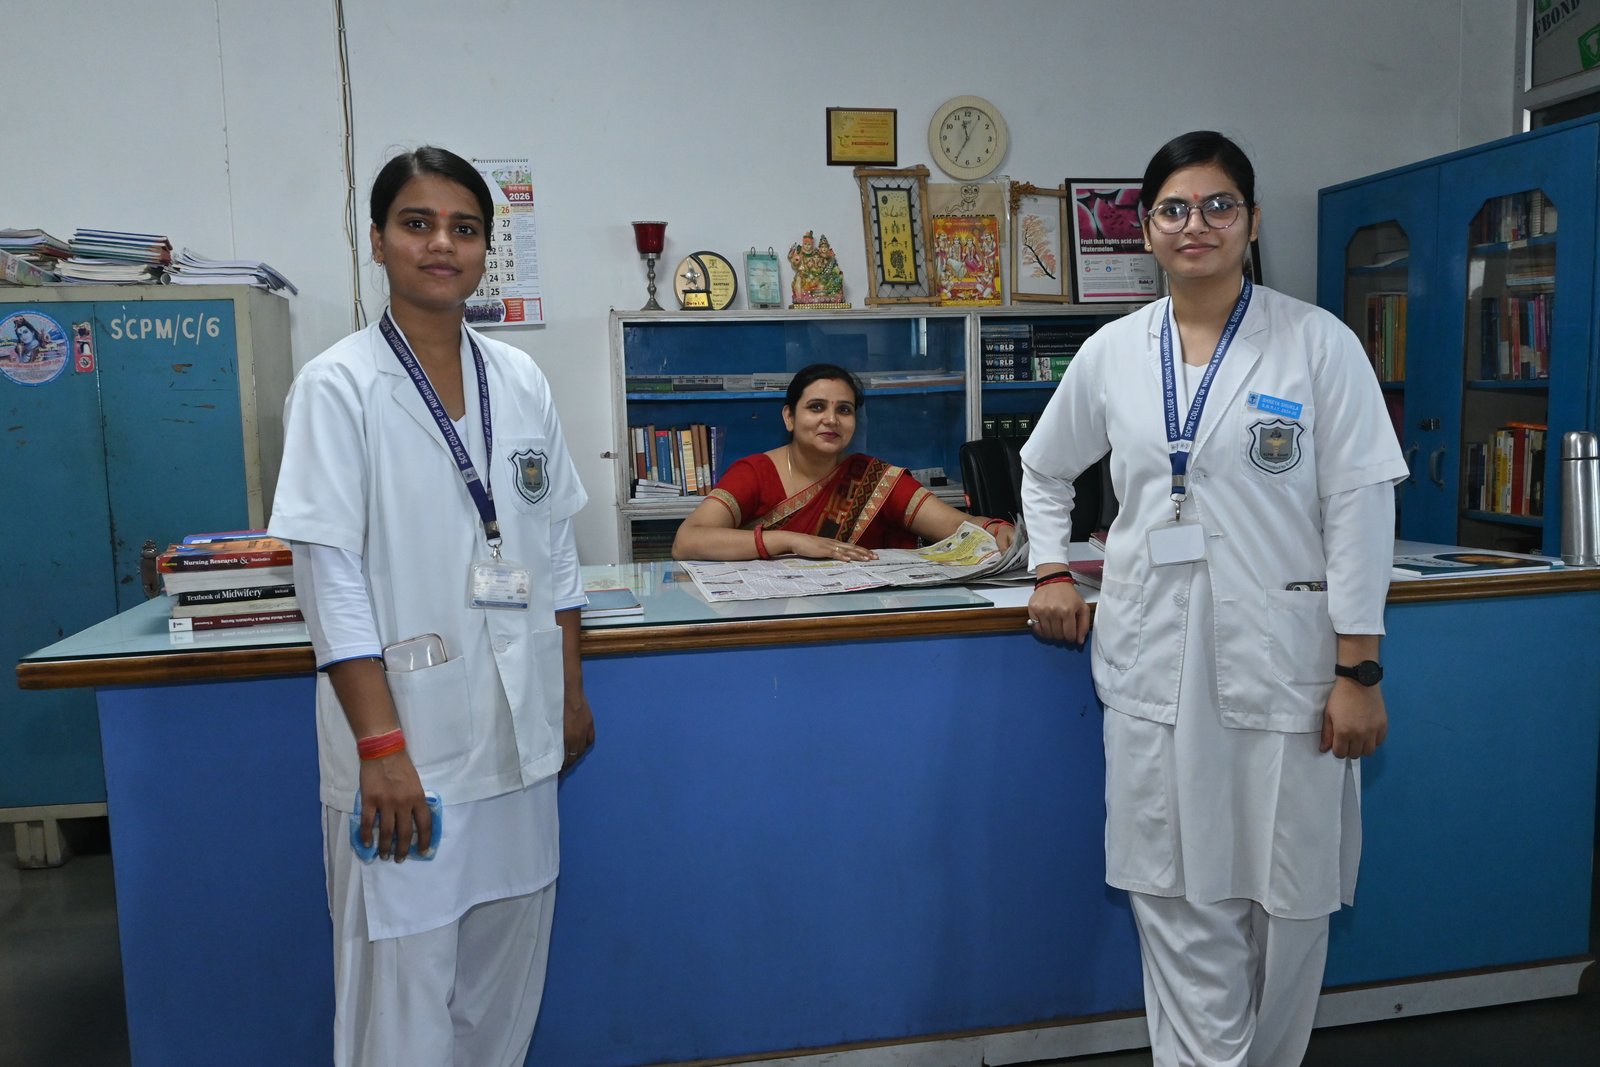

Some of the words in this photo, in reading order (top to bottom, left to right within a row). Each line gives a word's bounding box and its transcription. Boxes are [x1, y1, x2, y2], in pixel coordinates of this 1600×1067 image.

[509, 192, 531, 201] 2026
[501, 206, 510, 214] 26
[502, 220, 511, 228] 27
[503, 233, 512, 242] 28
[489, 261, 498, 269] 23
[505, 260, 514, 268] 30
[489, 274, 499, 283] 24
[506, 273, 515, 282] 31
[475, 289, 484, 297] 18
[491, 288, 500, 296] 25
[110, 313, 220, 345] SCPM/C/6
[387, 331, 414, 368] PARAMEDICAL
[410, 366, 424, 381] AND
[1165, 366, 1173, 389] NURSING
[1184, 421, 1195, 438] SCPM
[1190, 396, 1204, 421] COLLEGE
[1198, 387, 1206, 396] OF
[1203, 364, 1216, 388] NURSING
[1216, 324, 1234, 360] PARAMEDICAL
[418, 380, 440, 408] NURSING
[1167, 390, 1173, 398] OF
[433, 408, 444, 418] OF
[1167, 398, 1176, 421] COLLEGE
[439, 417, 459, 446] COLLEGE
[1168, 422, 1178, 439] SCPM
[454, 446, 467, 465] SCPM
[183, 559, 209, 567] Nursing
[210, 558, 238, 566] Research
[239, 556, 249, 565] &
[186, 593, 214, 601] Textbook
[221, 588, 263, 599] Midwifery
